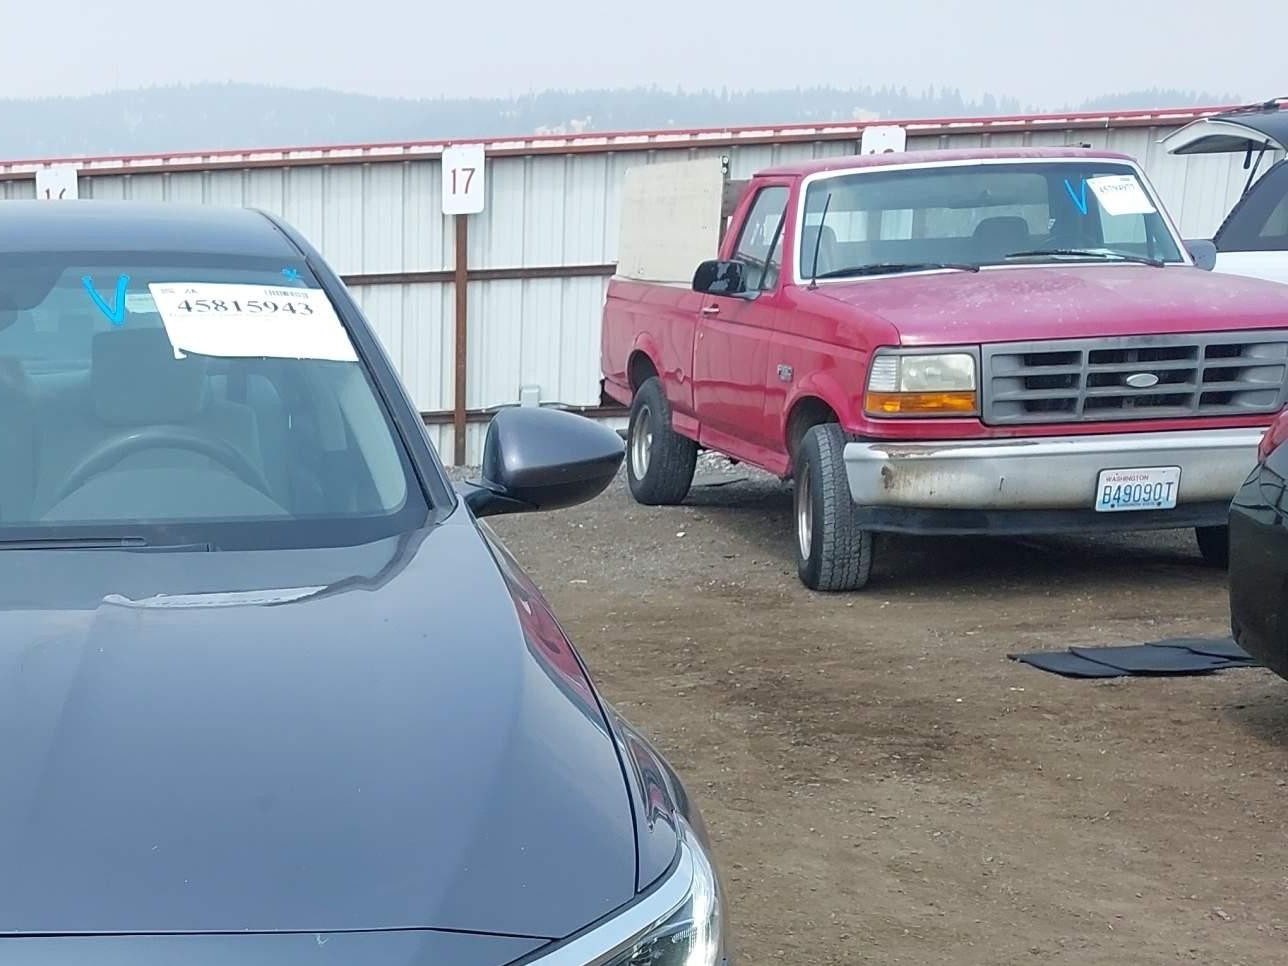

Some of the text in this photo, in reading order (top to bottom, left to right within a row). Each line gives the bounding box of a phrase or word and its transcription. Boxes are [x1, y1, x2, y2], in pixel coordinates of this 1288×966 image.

[451, 167, 476, 195] 17
[177, 299, 314, 316] 45815943
[1105, 474, 1150, 483] WASHINGTON
[1102, 481, 1174, 505] B49090T
